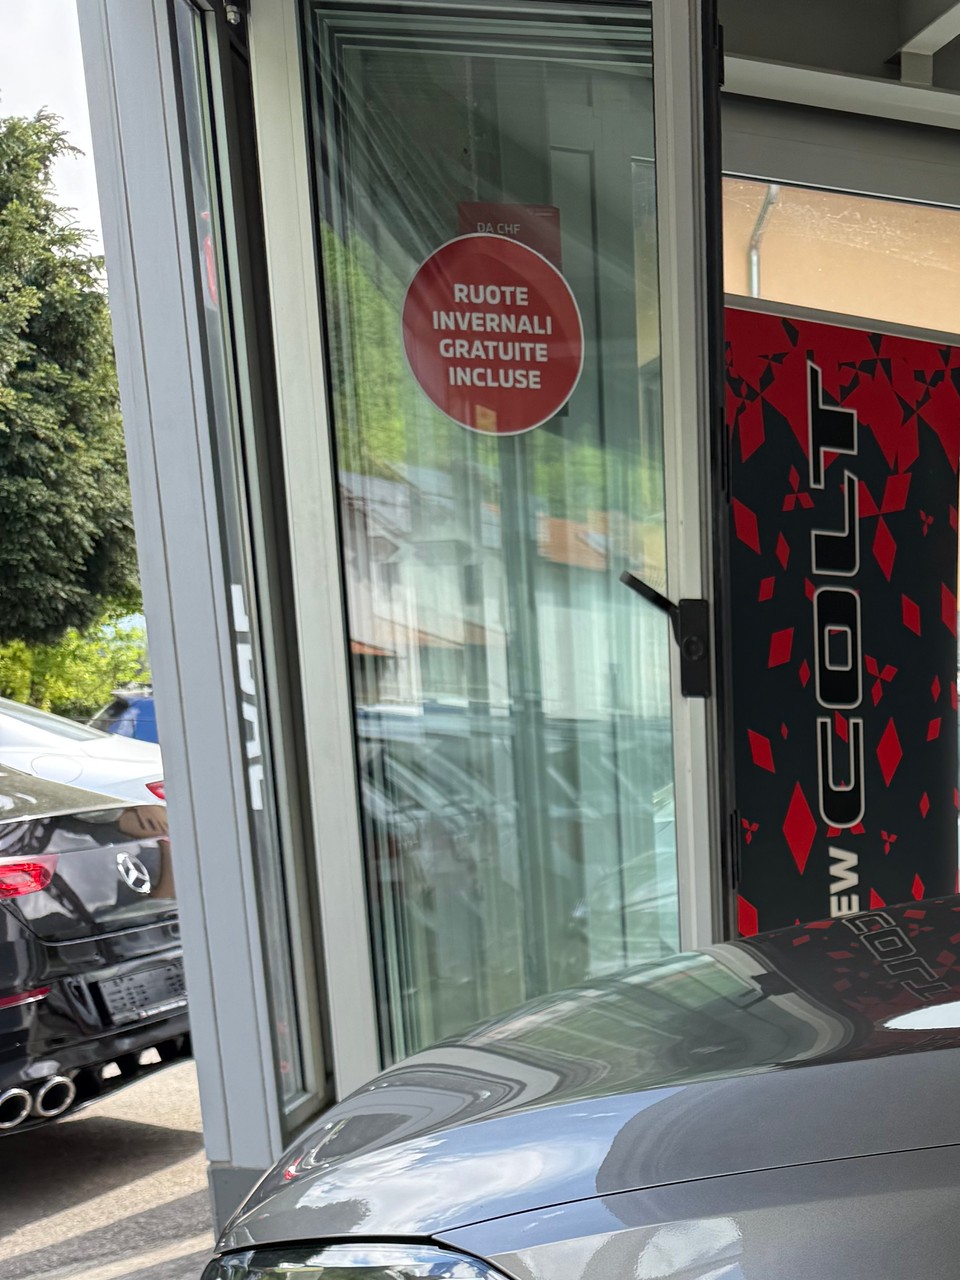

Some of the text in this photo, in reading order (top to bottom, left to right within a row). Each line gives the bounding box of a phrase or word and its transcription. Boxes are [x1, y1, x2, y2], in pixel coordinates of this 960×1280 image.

[477, 222, 520, 235] DA CHF
[453, 283, 529, 306] RUOTE
[432, 310, 553, 335] INVERNALI
[439, 339, 548, 362] GRATUITE
[449, 366, 541, 389] INCLUSE
[806, 359, 866, 918] EW COLT
